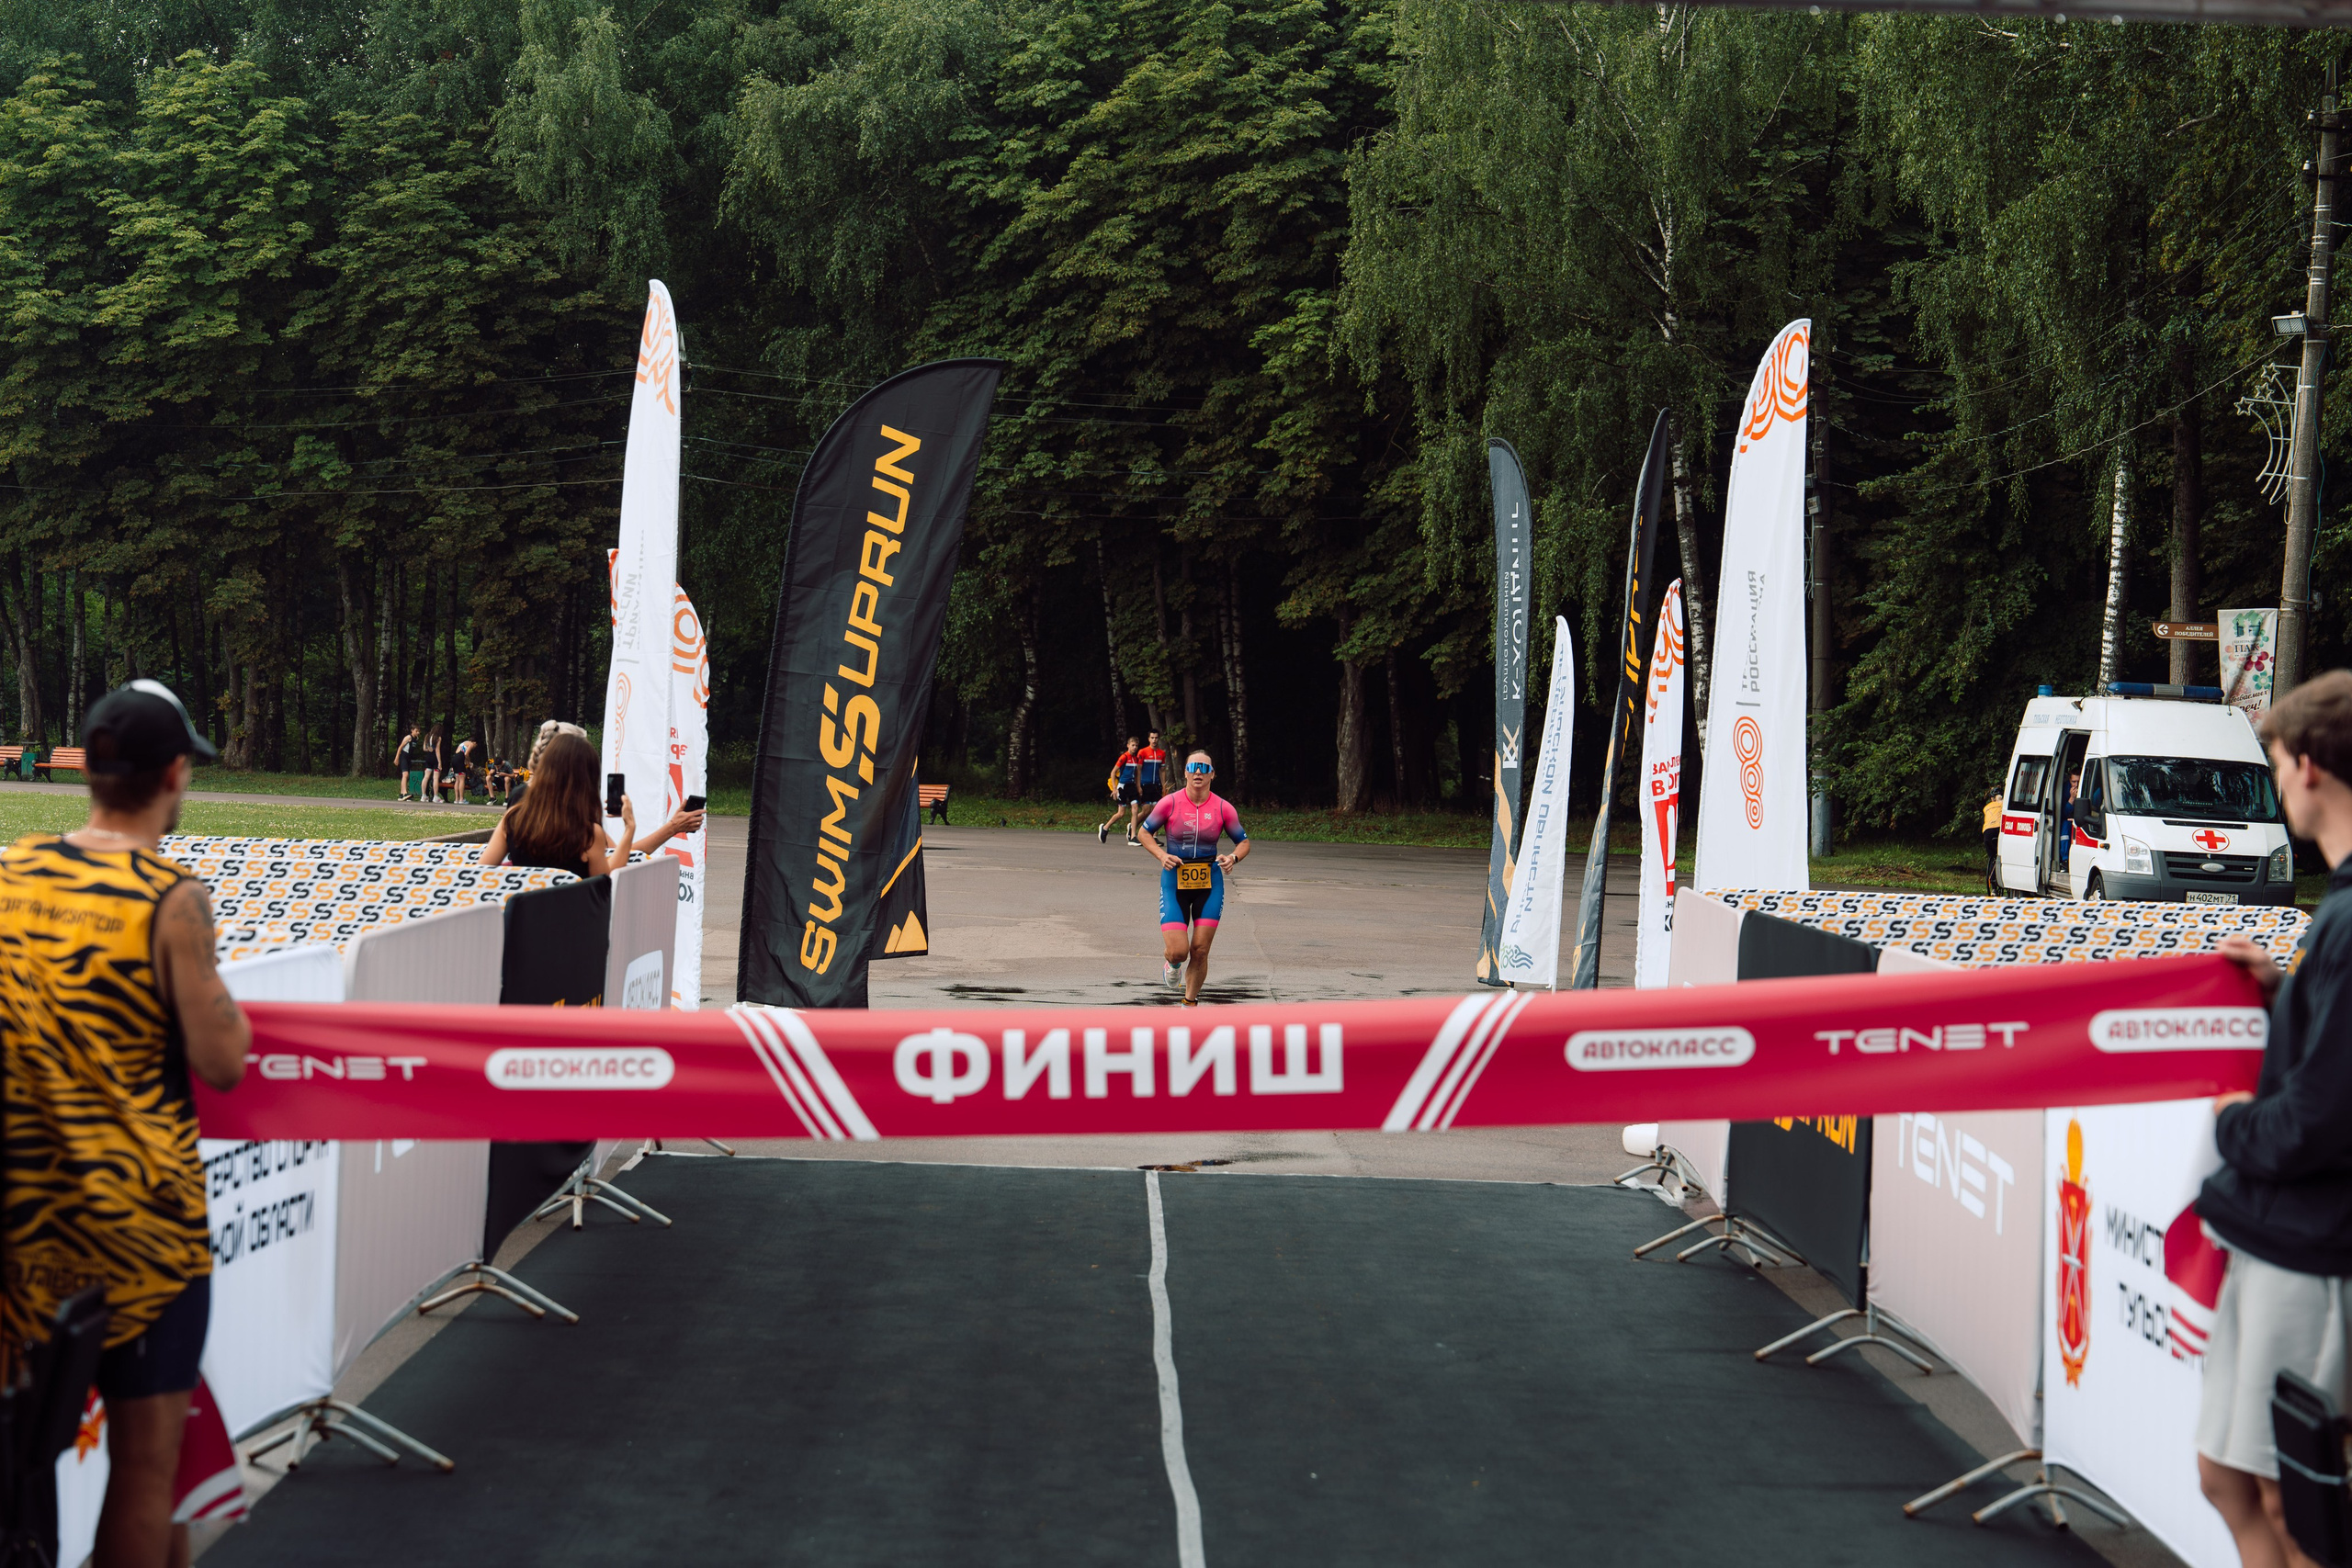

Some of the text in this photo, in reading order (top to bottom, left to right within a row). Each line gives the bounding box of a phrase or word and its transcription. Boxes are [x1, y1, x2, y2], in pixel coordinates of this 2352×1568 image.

[1182, 868, 1207, 882] 505
[1814, 1021, 2030, 1055] TENET
[2109, 1017, 2264, 1041] АВТОКЛАСС
[1582, 1035, 1738, 1061] АВТОКЛАСС
[503, 1055, 657, 1080] АВТОКЛАСС
[892, 1022, 1345, 1105] ФИНИШ
[203, 1139, 273, 1200] ТЕРСТВО
[1896, 1111, 2016, 1236] TENET
